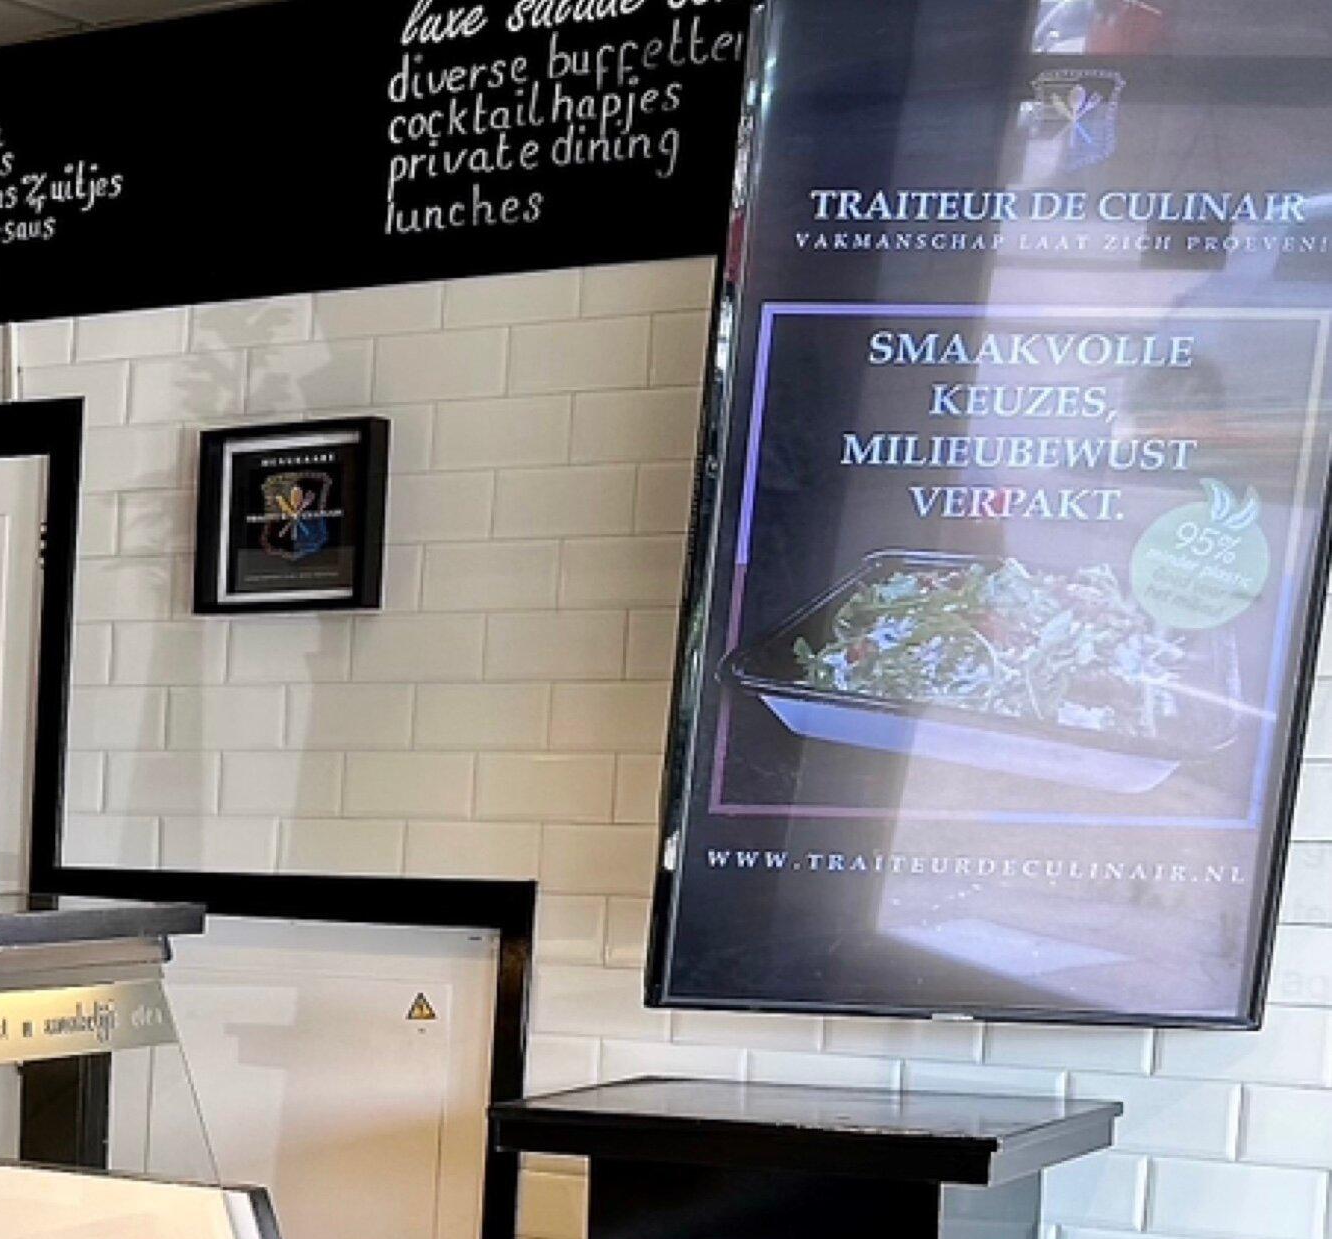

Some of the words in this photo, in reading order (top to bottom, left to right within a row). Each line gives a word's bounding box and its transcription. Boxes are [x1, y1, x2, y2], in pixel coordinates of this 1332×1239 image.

[388, 52, 529, 103] diverse
[387, 131, 539, 203] private
[551, 124, 683, 179] dining
[384, 183, 545, 235] lunches
[810, 188, 1019, 222] TRAITEUR
[1031, 190, 1087, 222] DE
[1098, 190, 1306, 223] CULINAIR
[795, 232, 1006, 251] VAKMANSCHAP
[1019, 235, 1090, 251] LAAT
[1104, 235, 1172, 251] ZICH
[869, 329, 1196, 369] SMAAKVOLLE
[929, 384, 1119, 422] KEUZES,
[840, 432, 1198, 471] MILIEUBEWUST
[909, 486, 1125, 522] VERPAKT.
[707, 849, 1246, 885] WWW.TRAITEURDECULINAIR.NL
